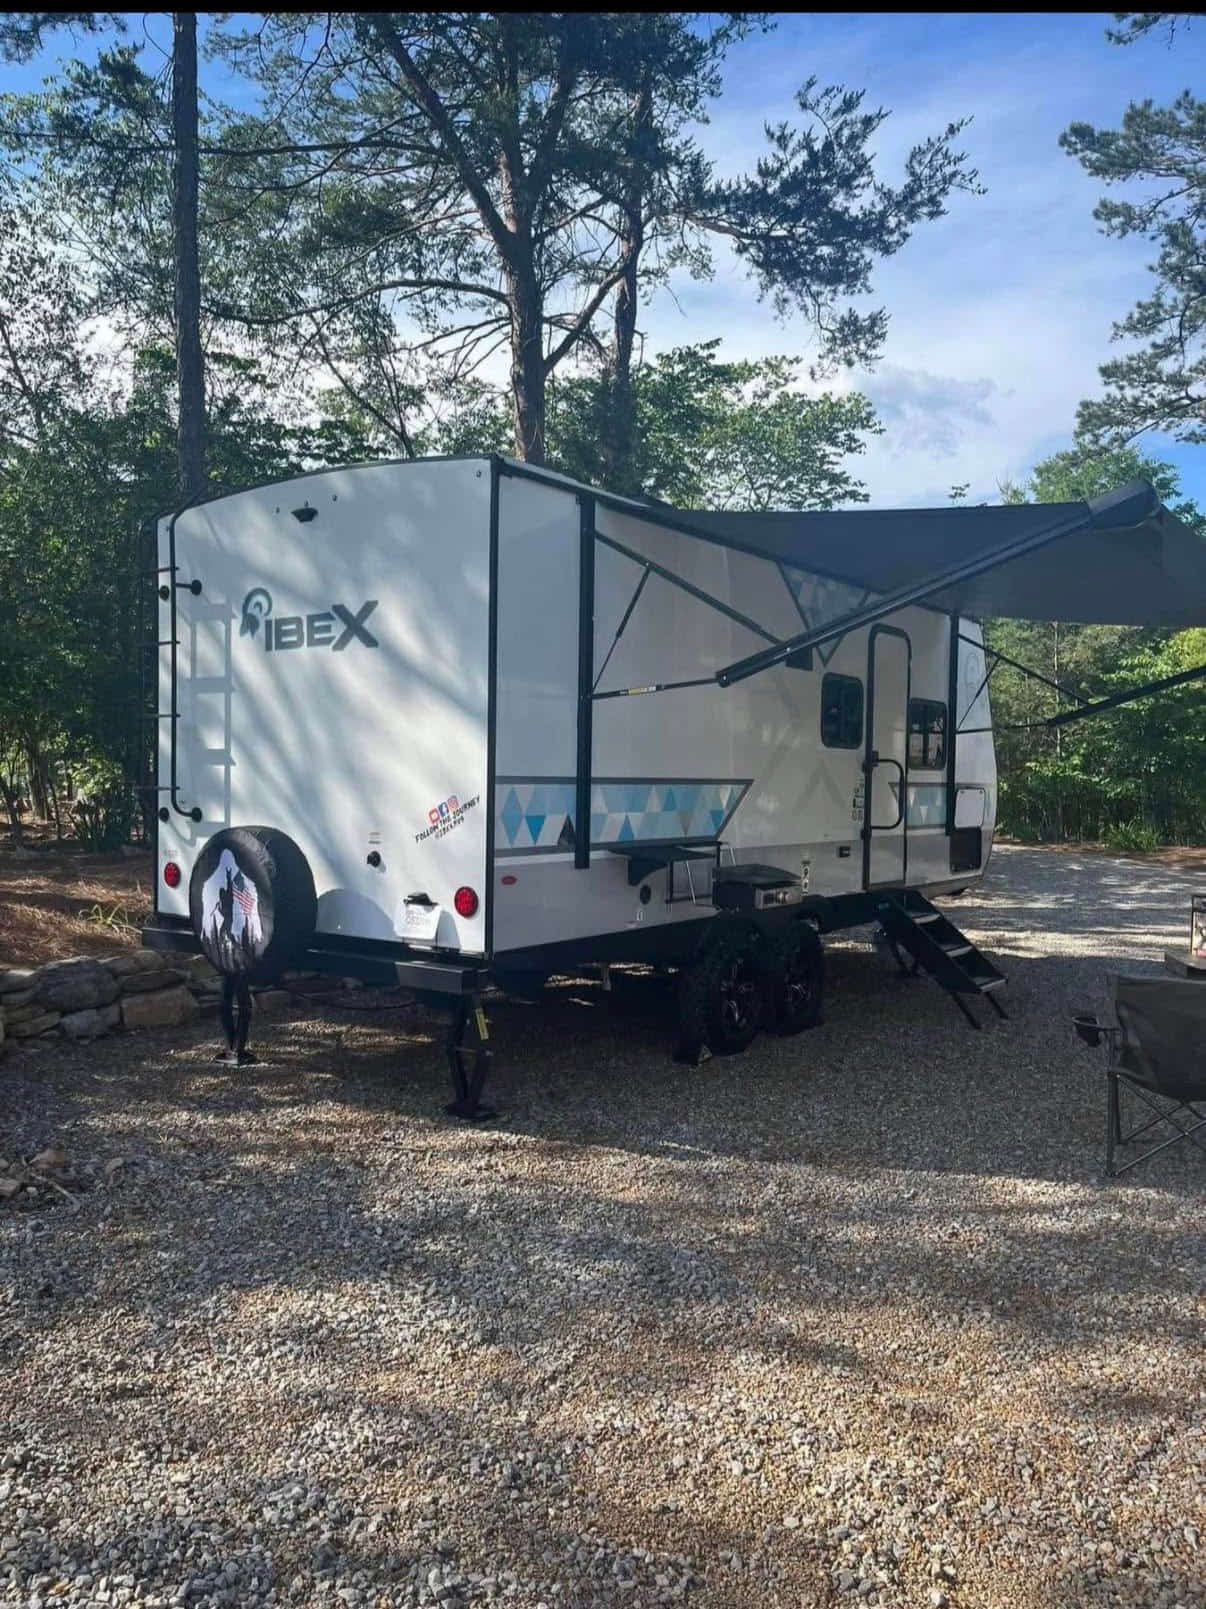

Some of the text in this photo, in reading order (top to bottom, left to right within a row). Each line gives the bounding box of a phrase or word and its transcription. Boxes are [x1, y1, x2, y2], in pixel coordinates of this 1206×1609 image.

[265, 600, 378, 651] IBEX
[415, 823, 439, 843] FOLLOW
[440, 815, 451, 827] THE
[452, 795, 480, 819] JOURNEY
